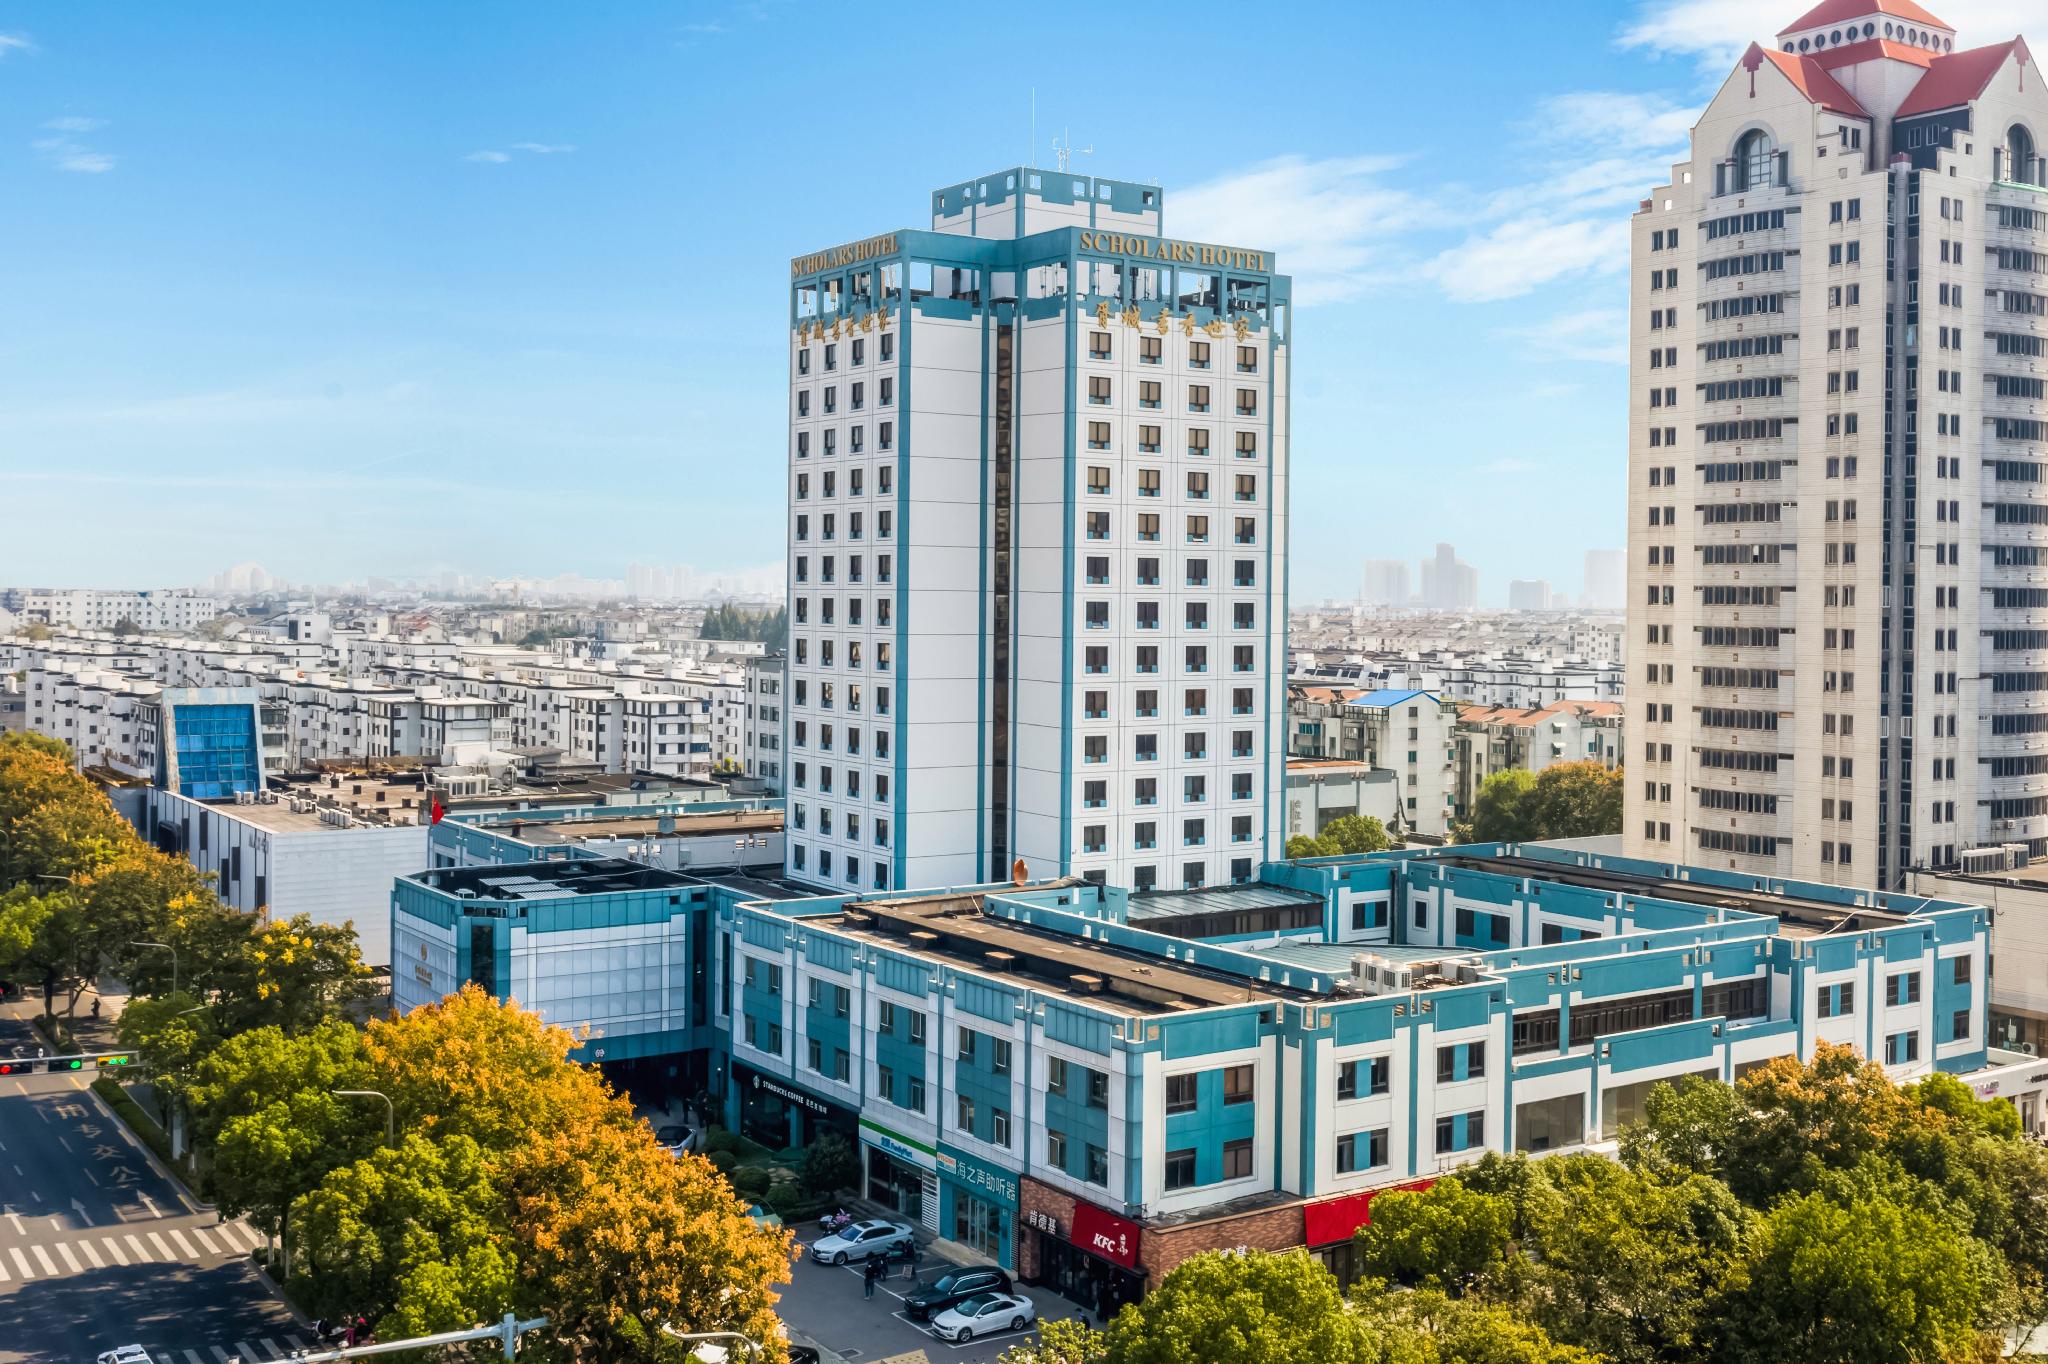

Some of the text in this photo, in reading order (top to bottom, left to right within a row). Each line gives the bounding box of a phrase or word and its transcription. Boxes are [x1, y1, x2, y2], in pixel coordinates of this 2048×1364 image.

[792, 234, 898, 277] SCHOLARS HOTEL
[1080, 231, 1270, 272] SCHOLARS HOTEL
[763, 1080, 804, 1104] STARBUCKS COFFEE
[957, 1160, 1016, 1202] 海之声助听器
[1029, 1209, 1057, 1235] 肯德基
[1093, 1232, 1116, 1253] KFC
